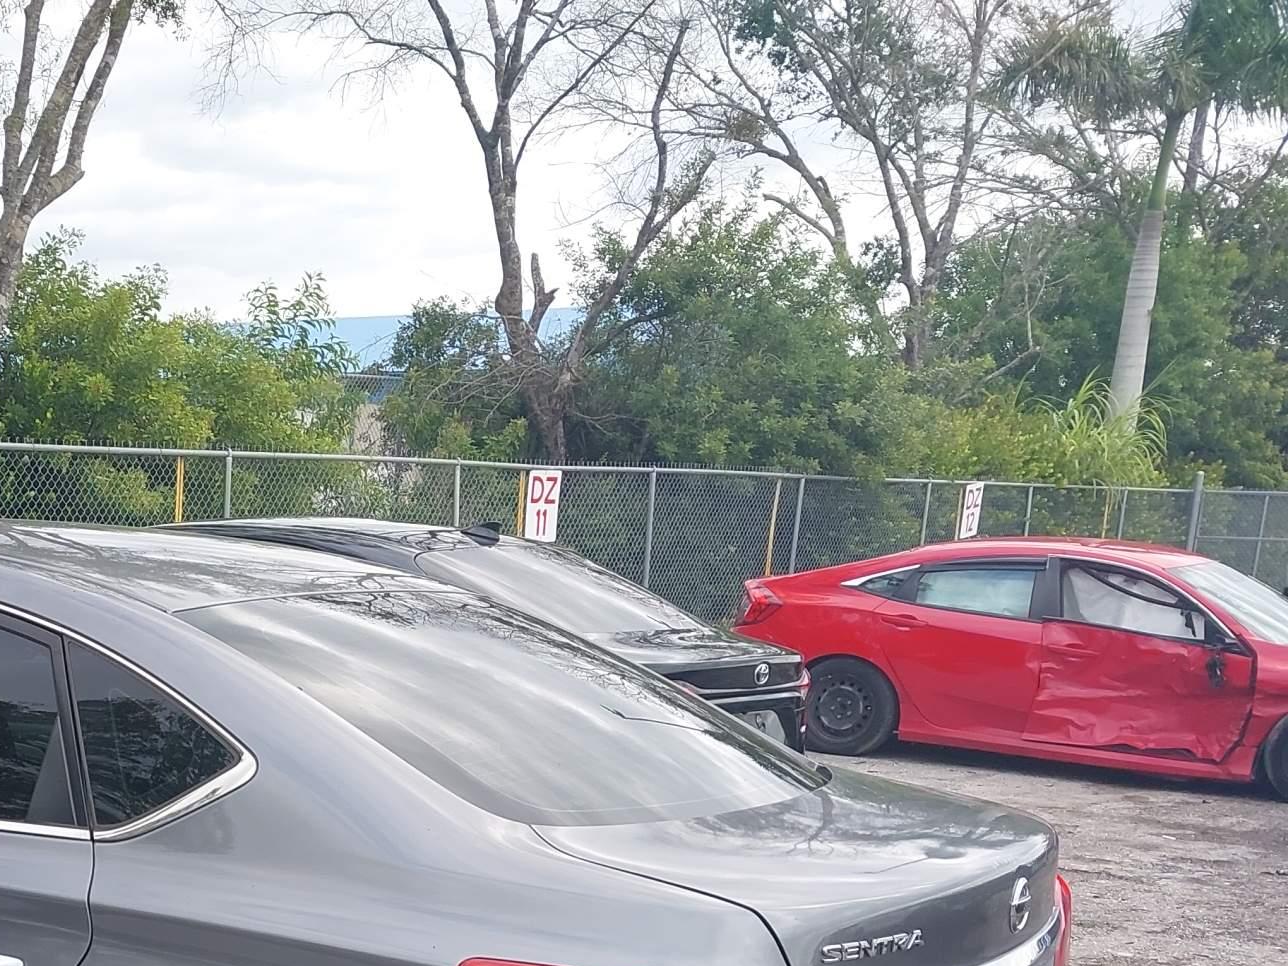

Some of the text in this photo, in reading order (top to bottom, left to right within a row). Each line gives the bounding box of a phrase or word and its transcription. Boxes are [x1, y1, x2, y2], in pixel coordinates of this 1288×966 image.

[530, 475, 558, 504] DZ
[966, 487, 982, 510] DZ
[536, 509, 547, 536] 11
[966, 512, 975, 532] 12
[821, 929, 925, 963] SENTRA
